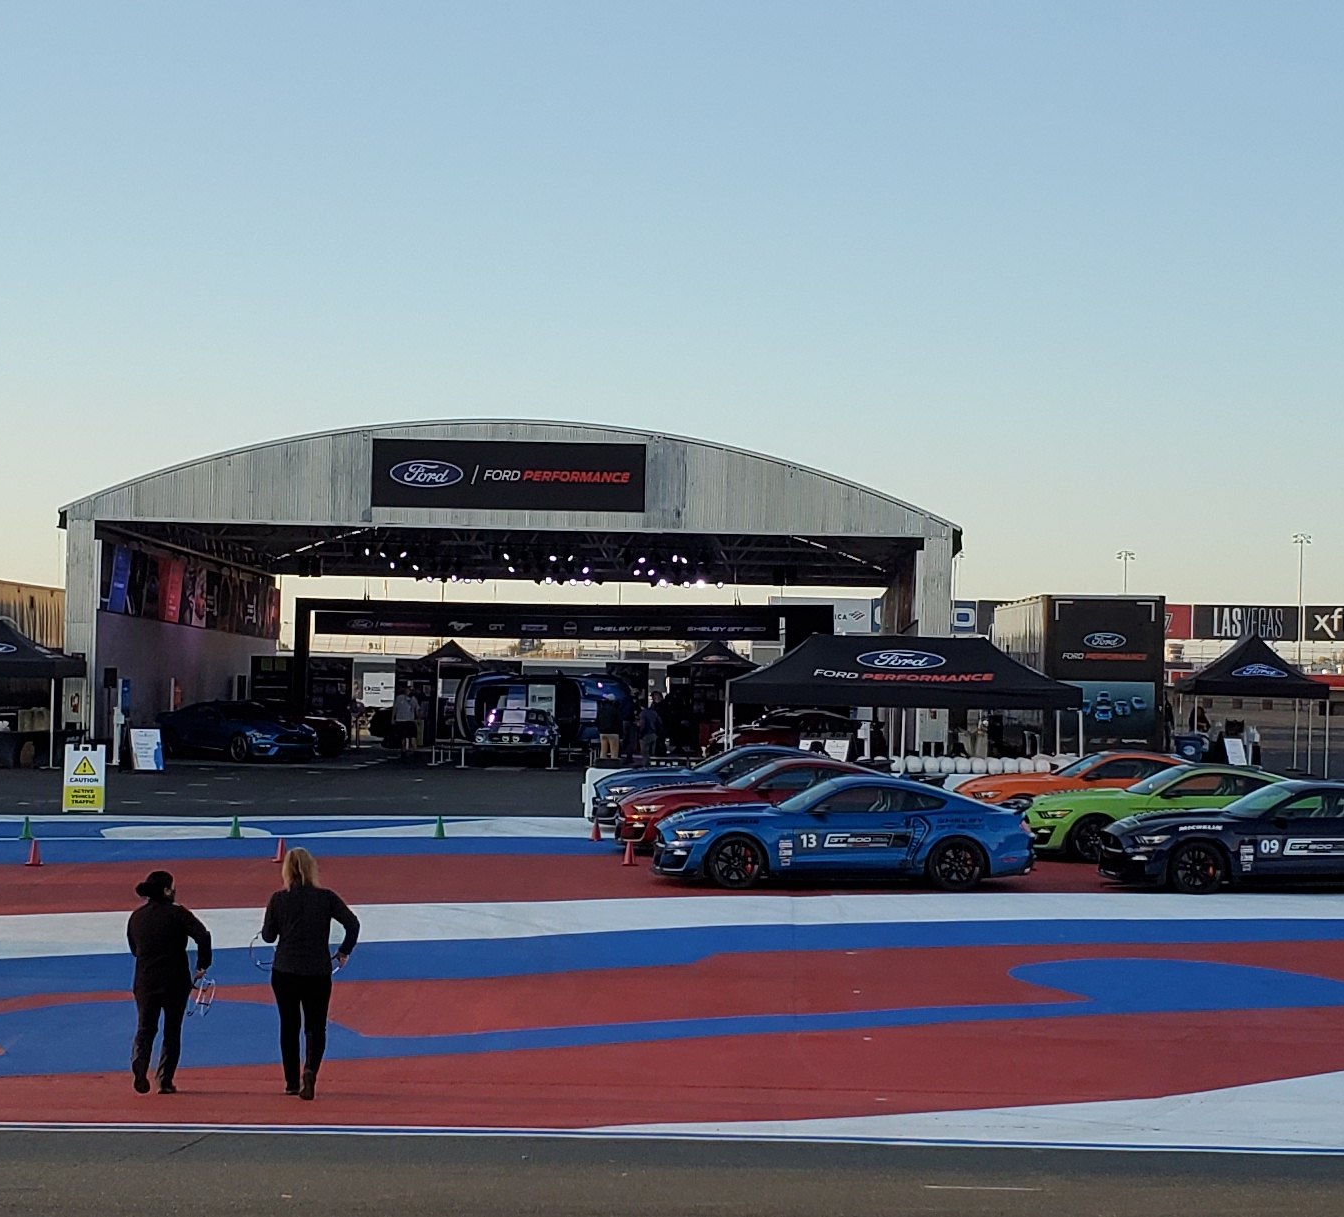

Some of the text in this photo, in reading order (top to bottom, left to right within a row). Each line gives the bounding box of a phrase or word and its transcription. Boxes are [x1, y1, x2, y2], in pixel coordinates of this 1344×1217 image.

[403, 463, 450, 483] Ford
[483, 469, 631, 483] FORD PERFORMANCE
[1213, 607, 1284, 638] LAS VEGAS
[874, 652, 929, 667] Ford
[1062, 652, 1084, 660] FORD
[813, 669, 995, 682] FORD PERFORMANCE
[800, 833, 817, 848] 13
[1260, 839, 1279, 854] 09
